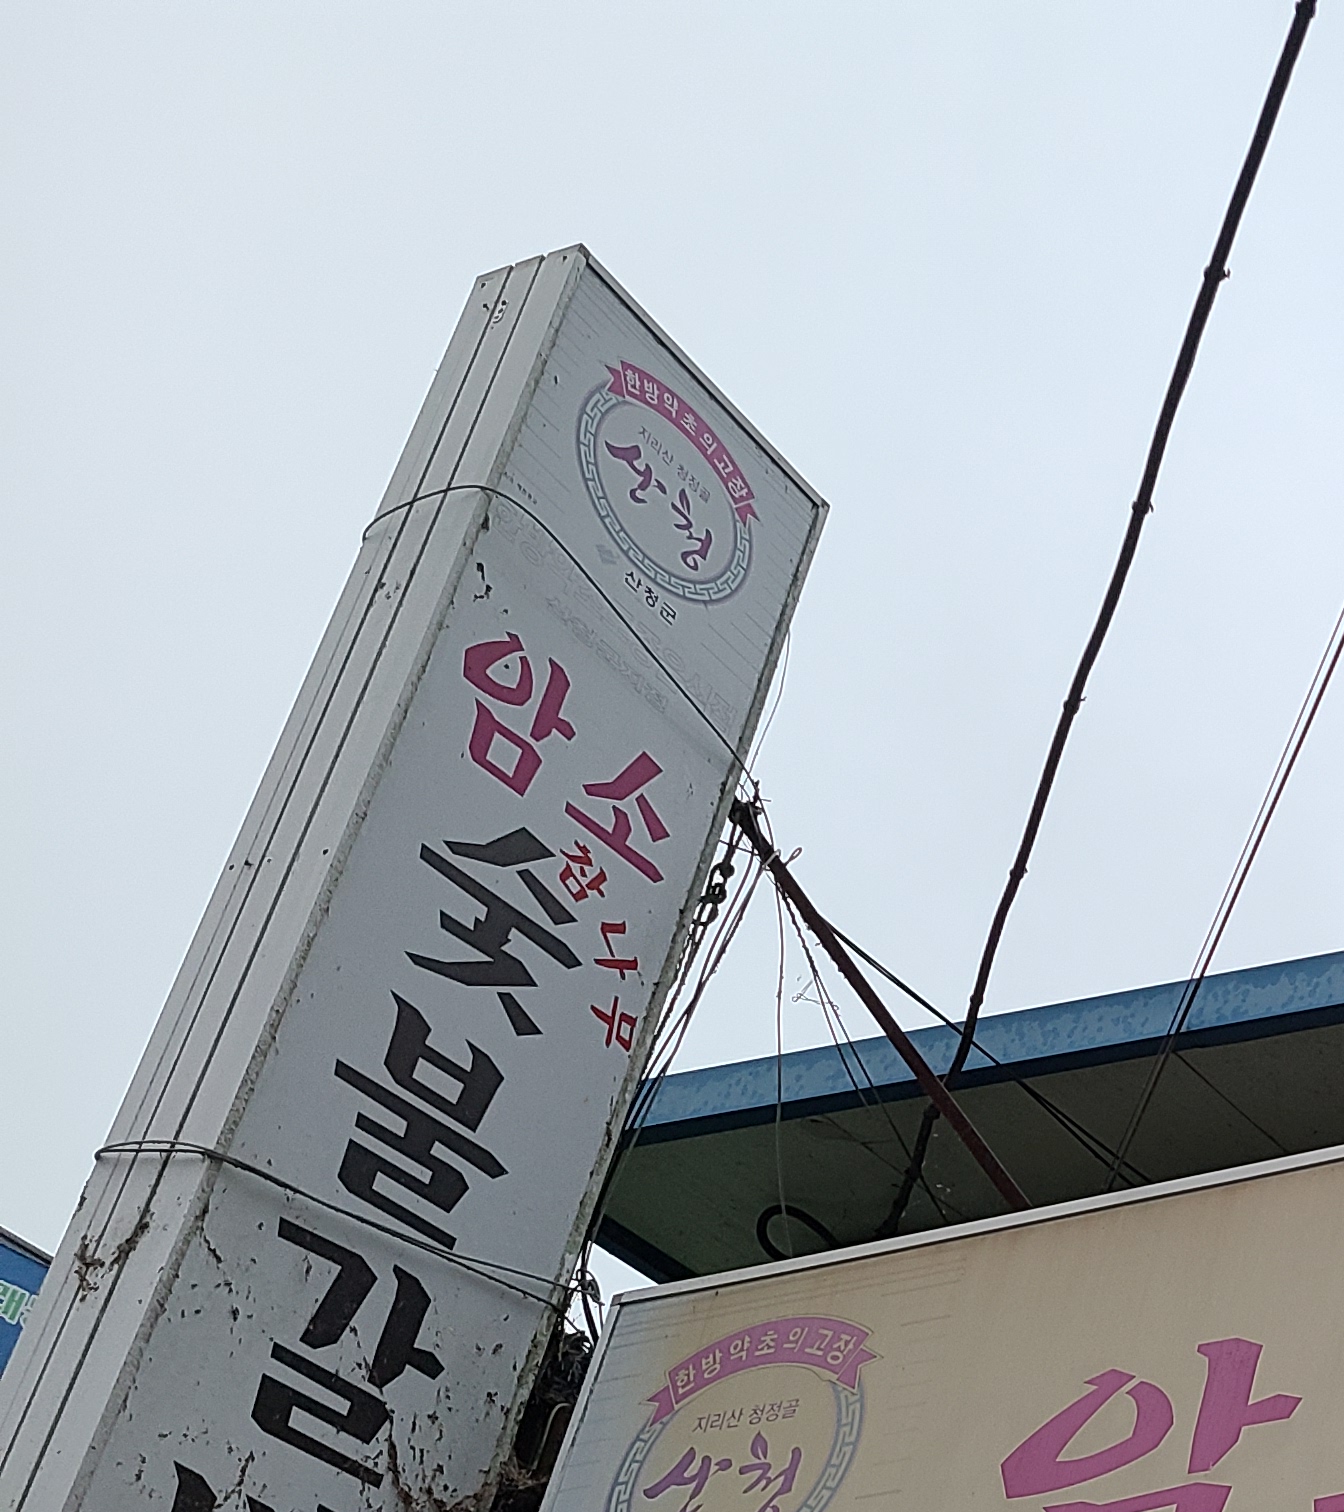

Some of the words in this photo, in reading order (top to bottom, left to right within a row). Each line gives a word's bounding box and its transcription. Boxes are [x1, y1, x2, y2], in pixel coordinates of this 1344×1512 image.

[637, 425, 675, 467] 지리산
[604, 440, 713, 571] 산청
[623, 570, 677, 626] 산청군
[463, 632, 670, 884] 암소
[558, 840, 641, 1050] 참나무
[691, 1406, 745, 1434] 지리산
[747, 1398, 801, 1426] 청정골
